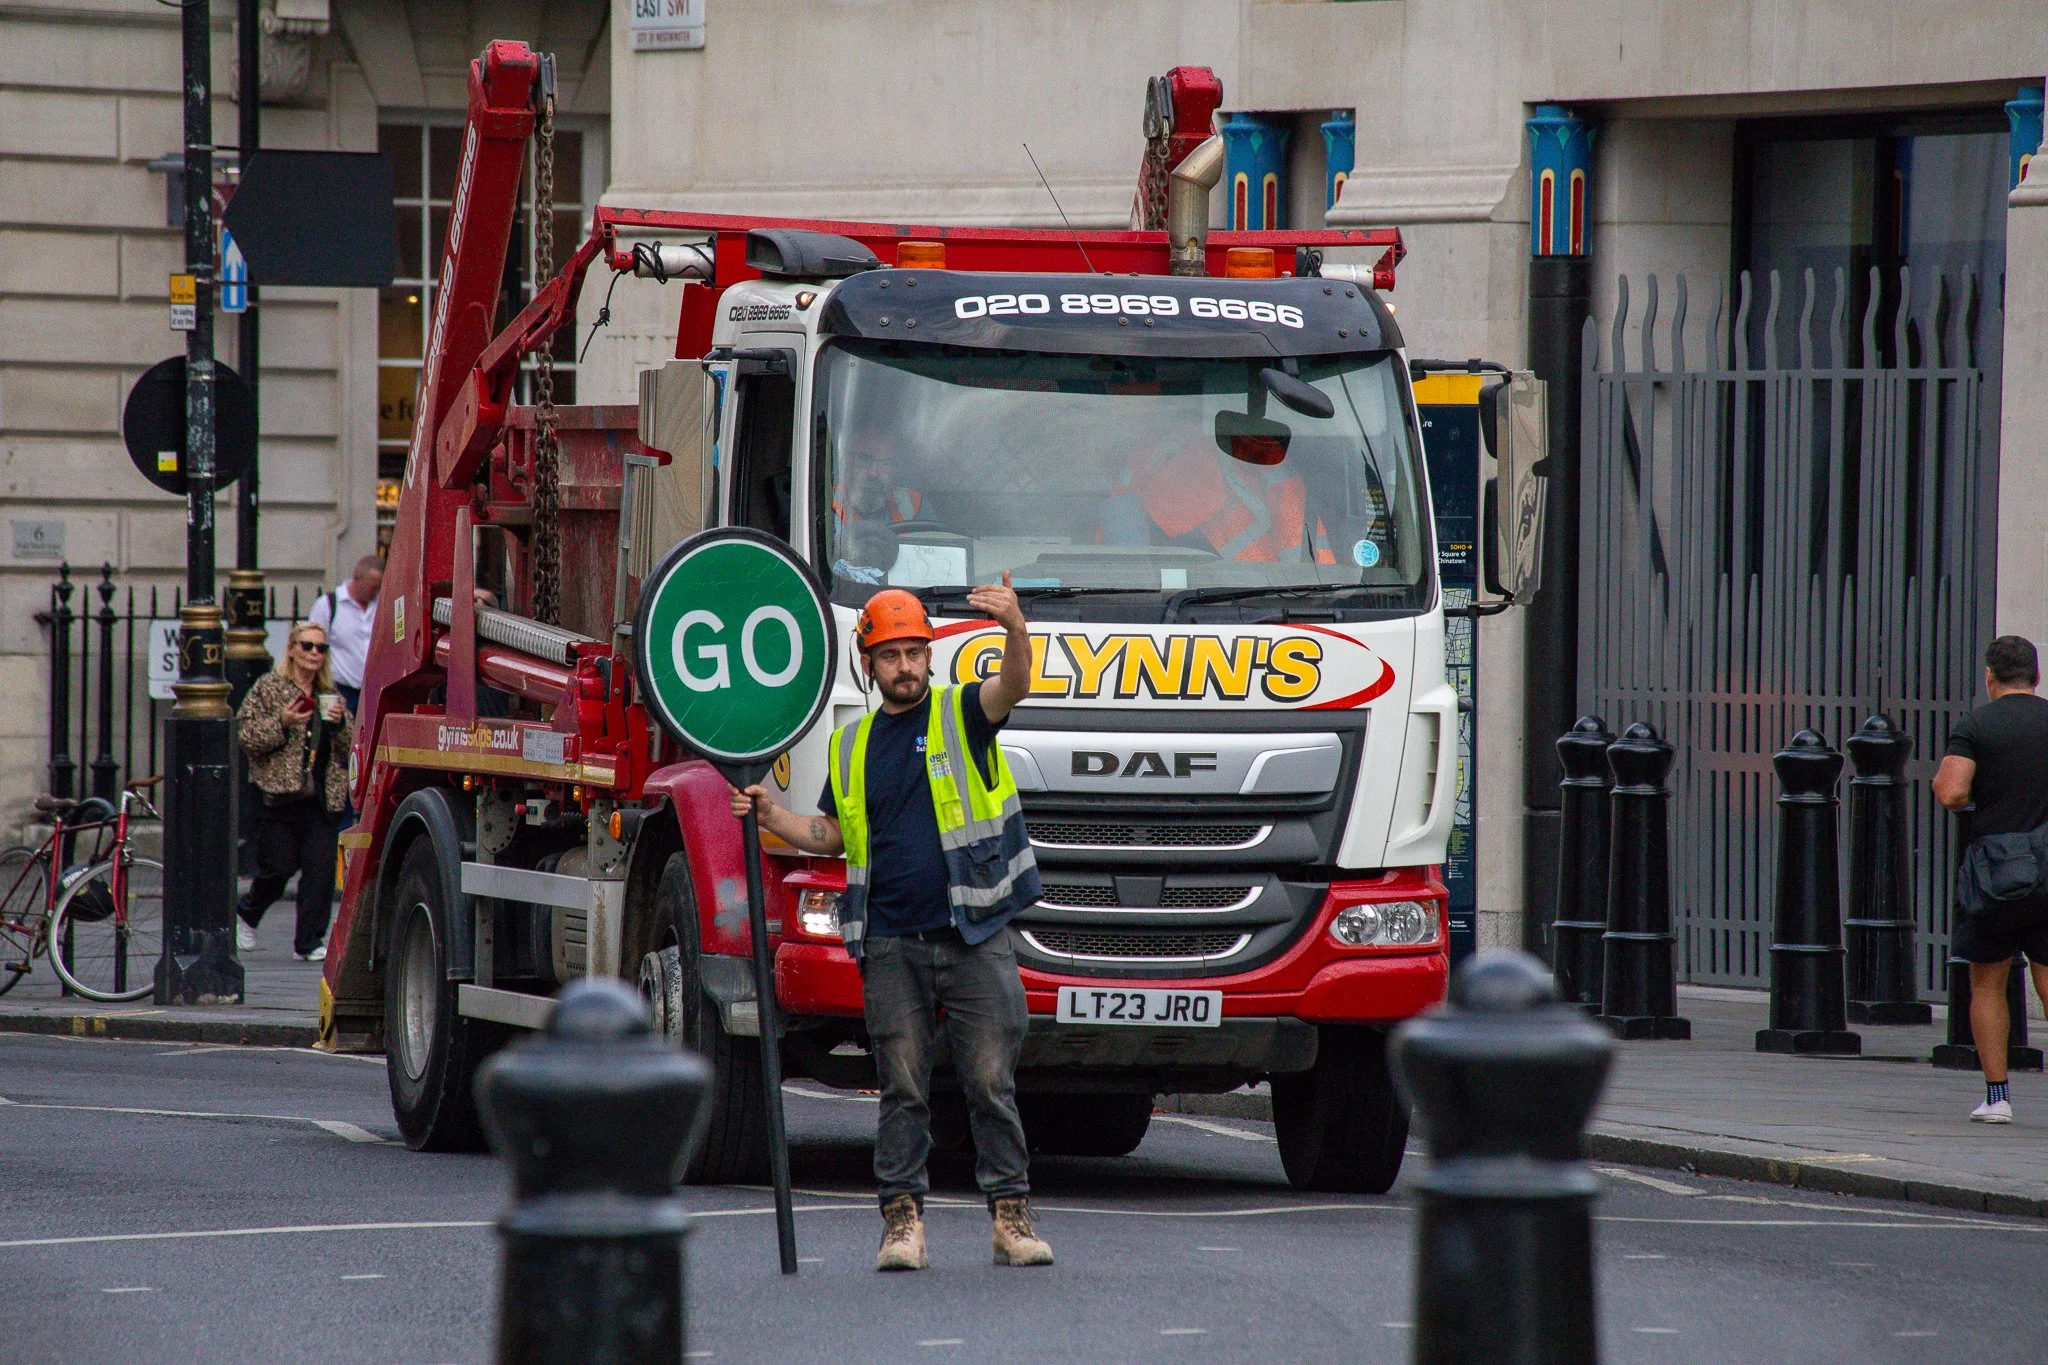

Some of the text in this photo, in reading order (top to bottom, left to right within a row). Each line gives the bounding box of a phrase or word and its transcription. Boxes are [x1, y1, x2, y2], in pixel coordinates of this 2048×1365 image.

[636, 0, 690, 18] EAST SW1
[427, 254, 452, 386] 8969
[450, 120, 477, 254] 6666
[729, 305, 792, 321] 020 8969 6666
[954, 294, 1305, 328] 020 8969 6666
[671, 605, 803, 693] GO
[950, 632, 1323, 701] GLYNN'S
[1071, 749, 1218, 778] DAF
[1070, 991, 1210, 1023] LT23 JRO
